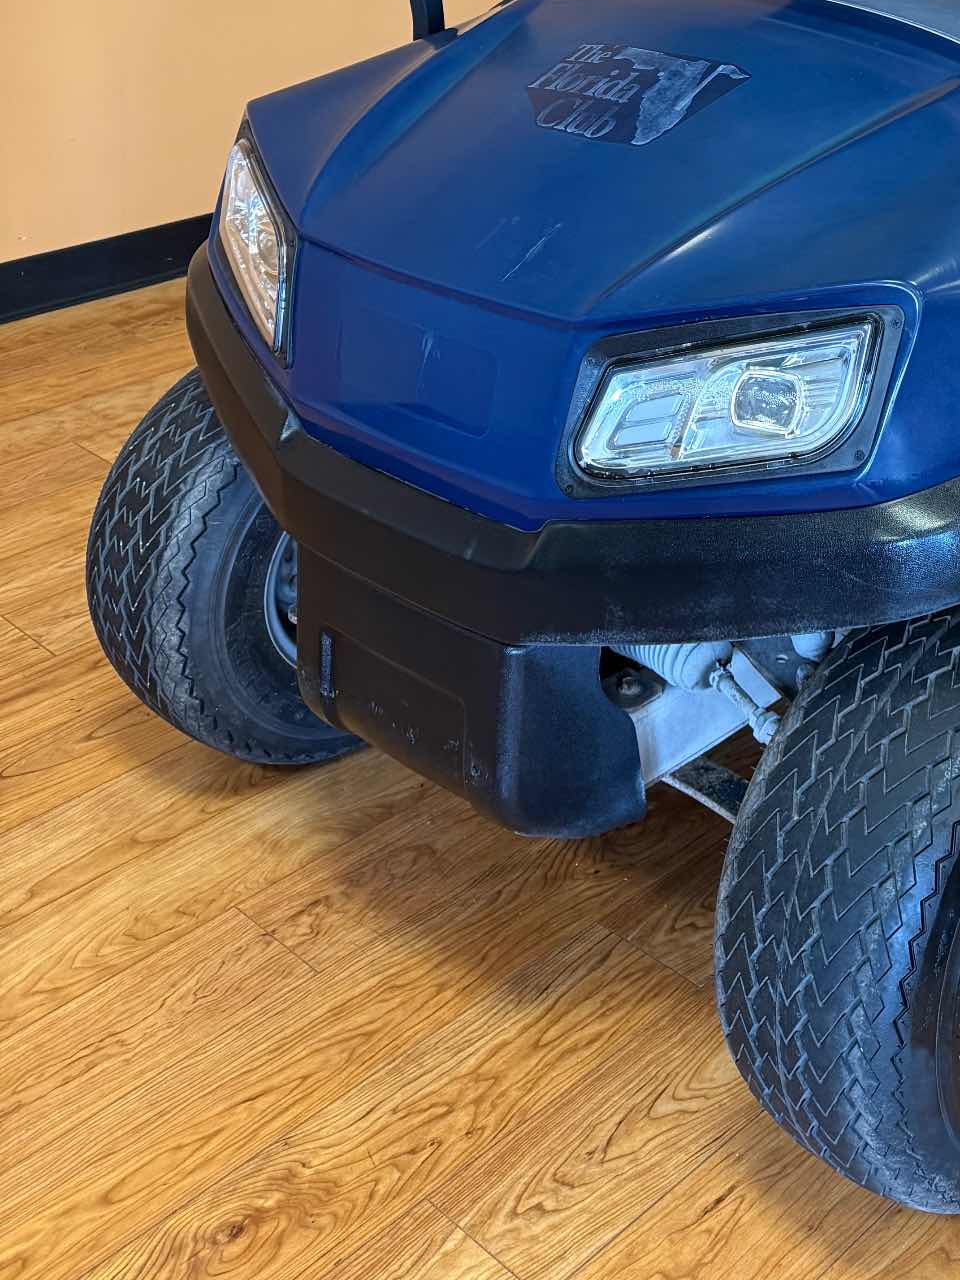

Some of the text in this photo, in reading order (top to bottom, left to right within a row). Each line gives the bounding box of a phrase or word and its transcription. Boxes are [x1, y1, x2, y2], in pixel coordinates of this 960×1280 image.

[566, 44, 611, 64] The
[527, 62, 641, 104] Florida
[535, 97, 620, 139] Club
